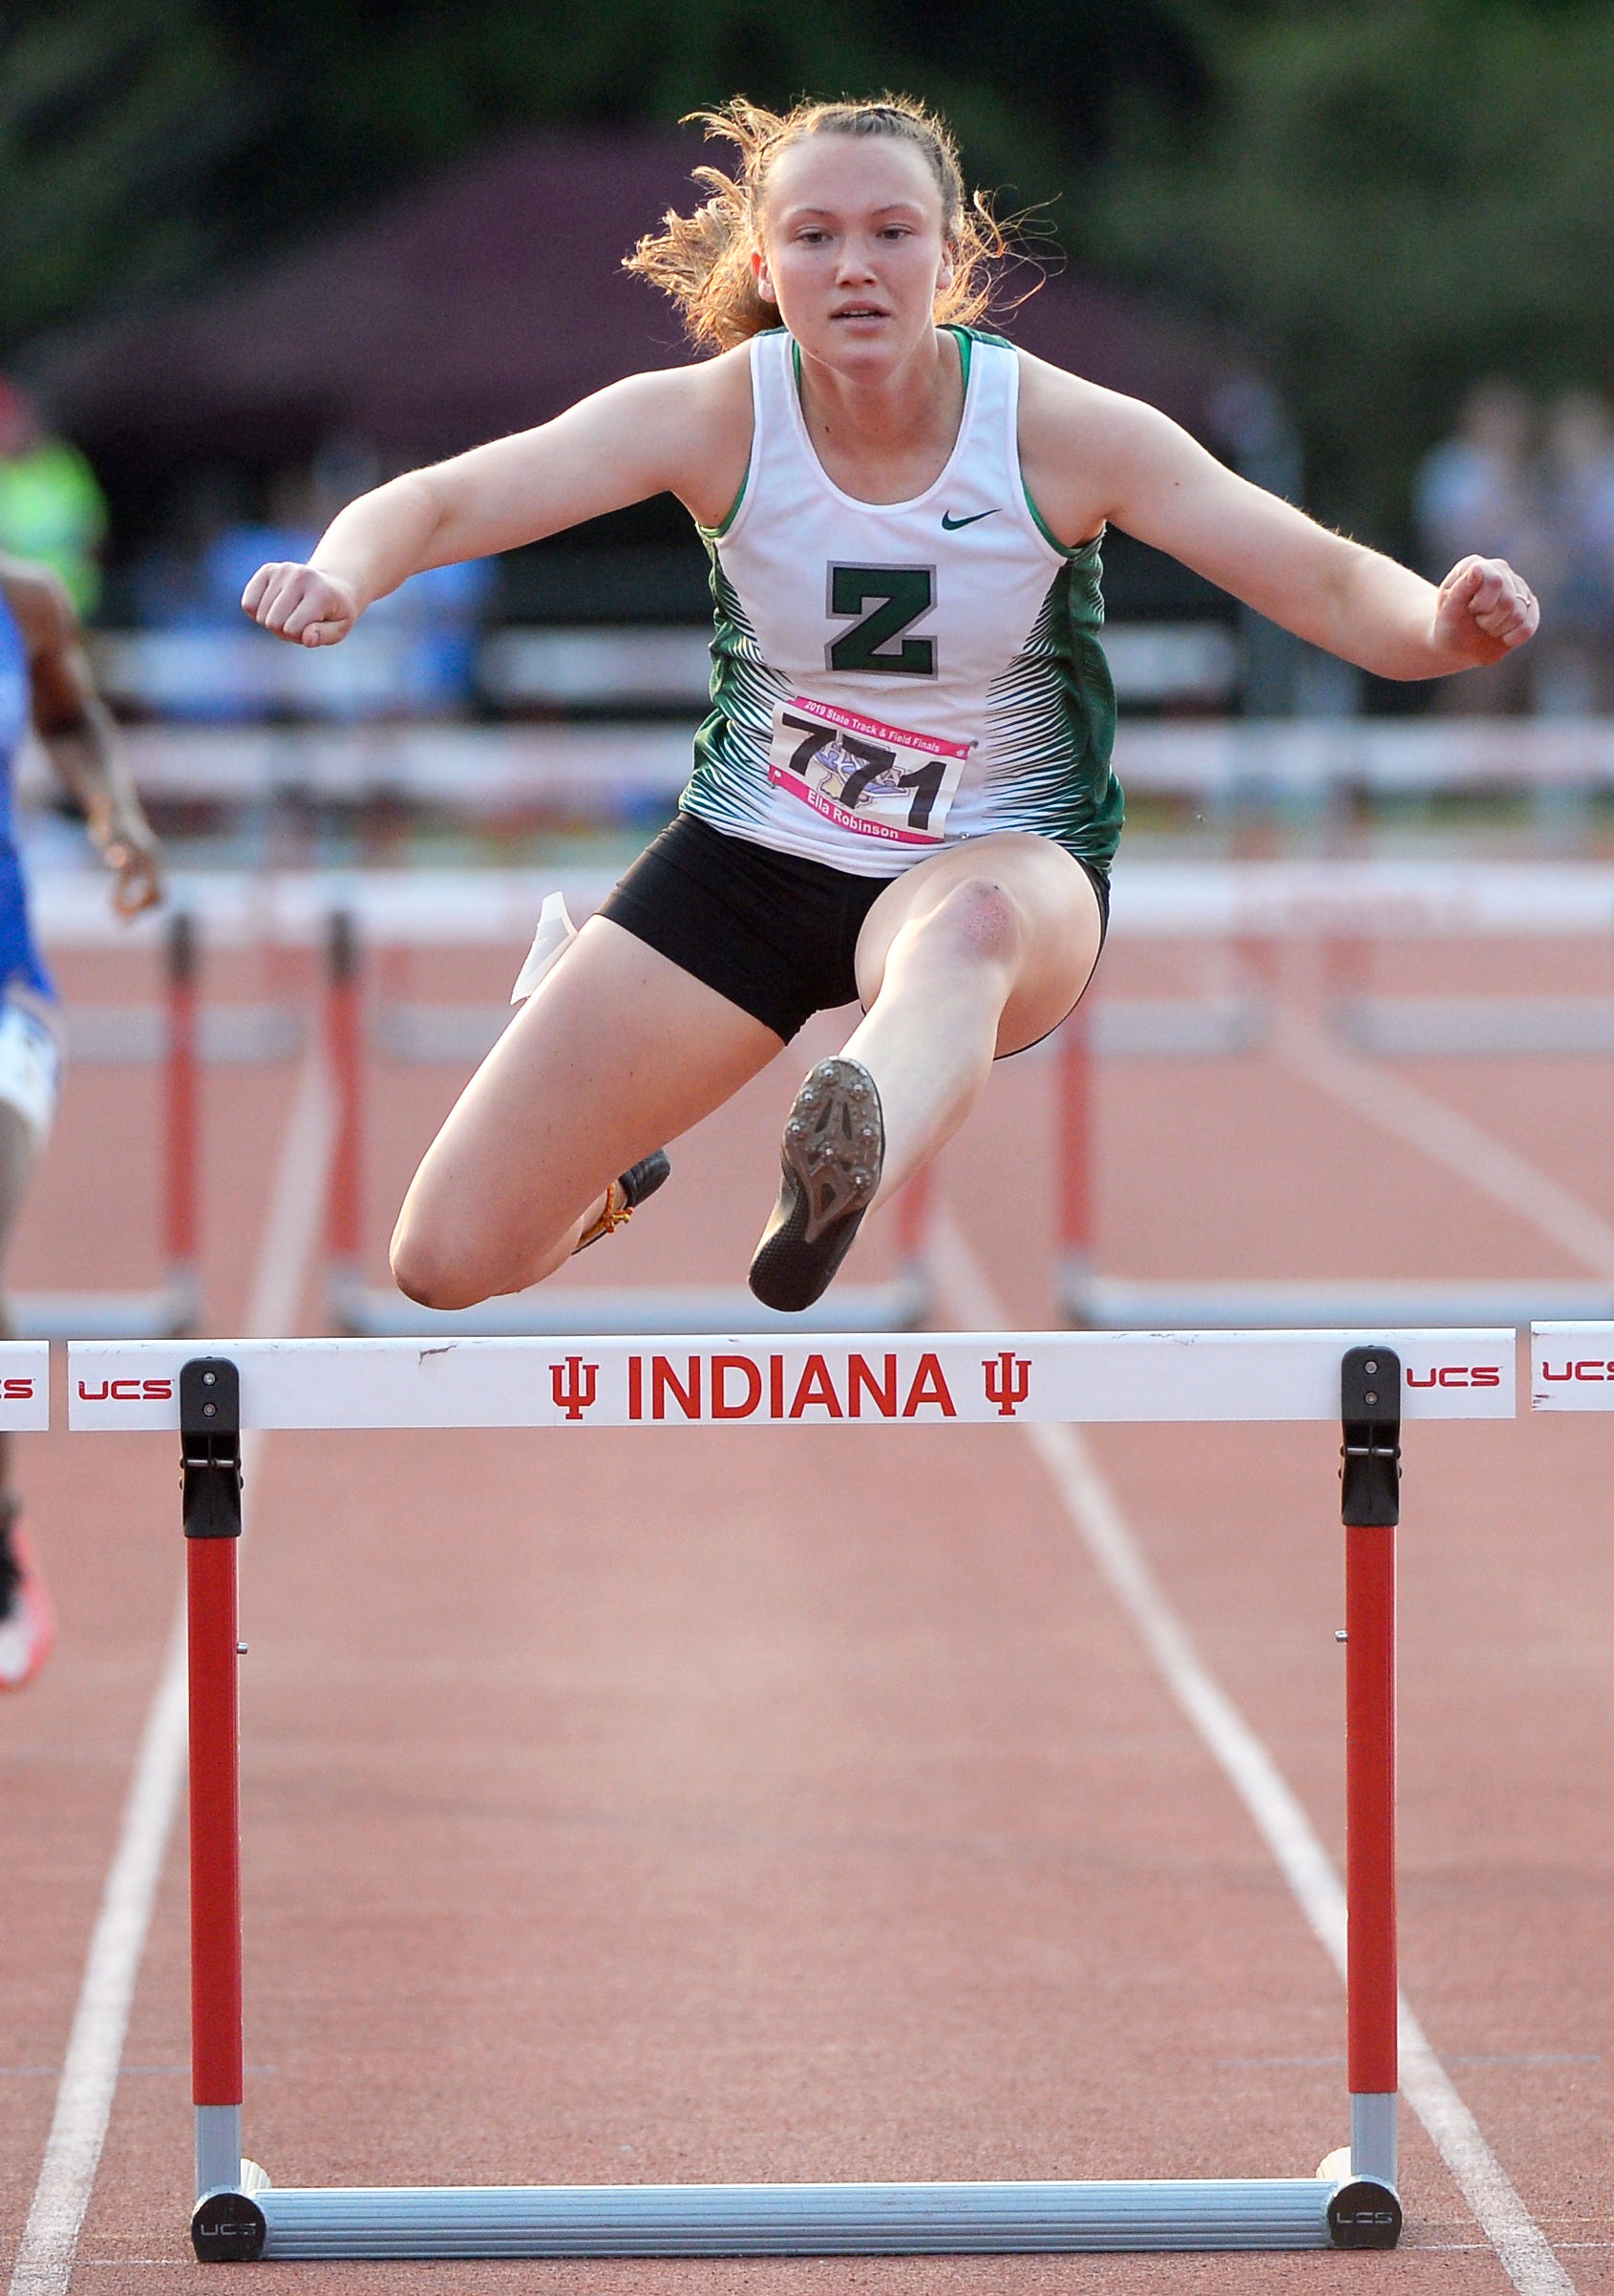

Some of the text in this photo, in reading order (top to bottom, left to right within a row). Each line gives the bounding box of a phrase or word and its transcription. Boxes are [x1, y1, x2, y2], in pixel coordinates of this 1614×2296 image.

[824, 561, 938, 680] Z
[804, 701, 940, 753] 2019 State Track & Field Finals
[782, 712, 946, 830] 771
[808, 790, 899, 839] Ella Robinson
[78, 1379, 173, 1400] UCS
[628, 1353, 957, 1419] INDIANA
[1407, 1367, 1500, 1387] UCS
[1542, 1361, 1614, 1381] UC
